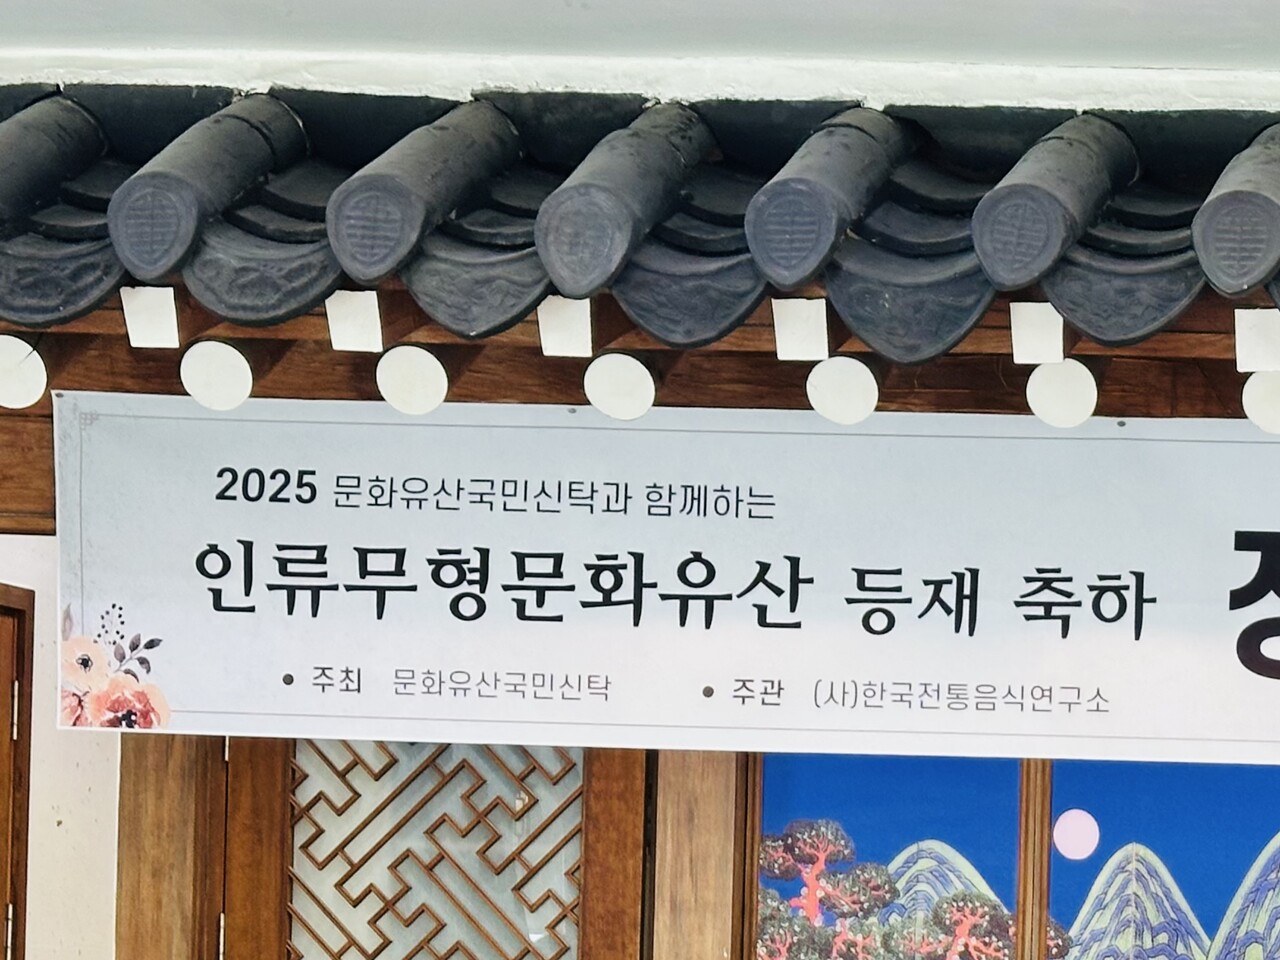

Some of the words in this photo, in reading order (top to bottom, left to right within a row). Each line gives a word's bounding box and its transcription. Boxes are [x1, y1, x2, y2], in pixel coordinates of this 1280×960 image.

[215, 466, 318, 505] 2025
[333, 474, 633, 516] 문화유산국민신탁과
[645, 482, 776, 520] 함께하는
[195, 538, 815, 630] 인류무형문화유산
[844, 567, 980, 638] 등재
[1013, 566, 1158, 642] 축하
[311, 666, 361, 694] 주최
[393, 668, 612, 702] 문화유산국민신탁
[732, 678, 785, 707] 주관
[813, 678, 1110, 714] (사)한국전통음식연구소
